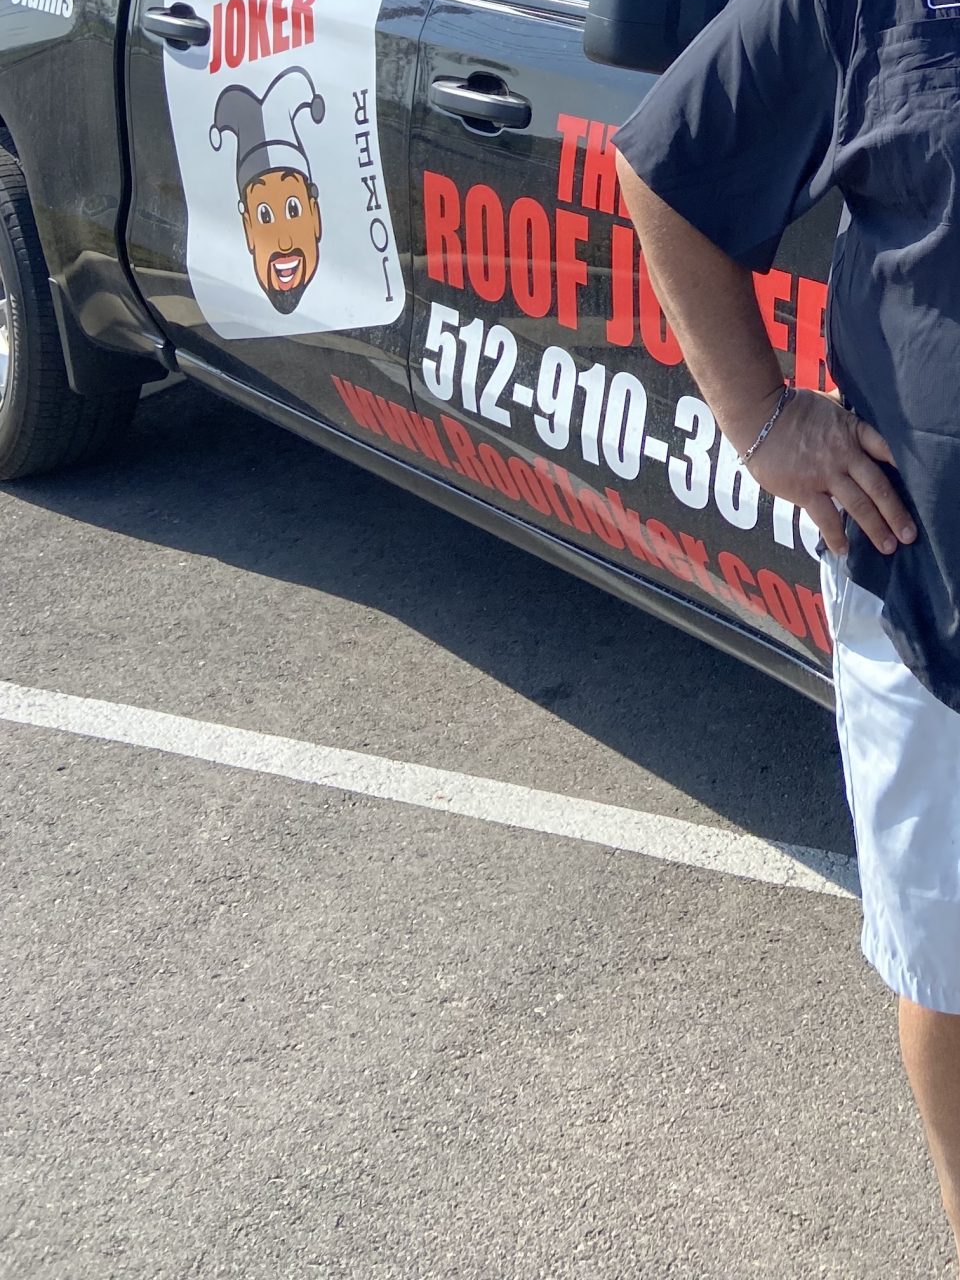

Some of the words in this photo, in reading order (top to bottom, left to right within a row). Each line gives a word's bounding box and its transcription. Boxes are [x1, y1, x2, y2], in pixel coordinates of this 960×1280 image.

[352, 88, 394, 303] JOKER
[556, 112, 632, 220] TH
[422, 170, 588, 330] ROOF
[606, 224, 838, 394] JOER
